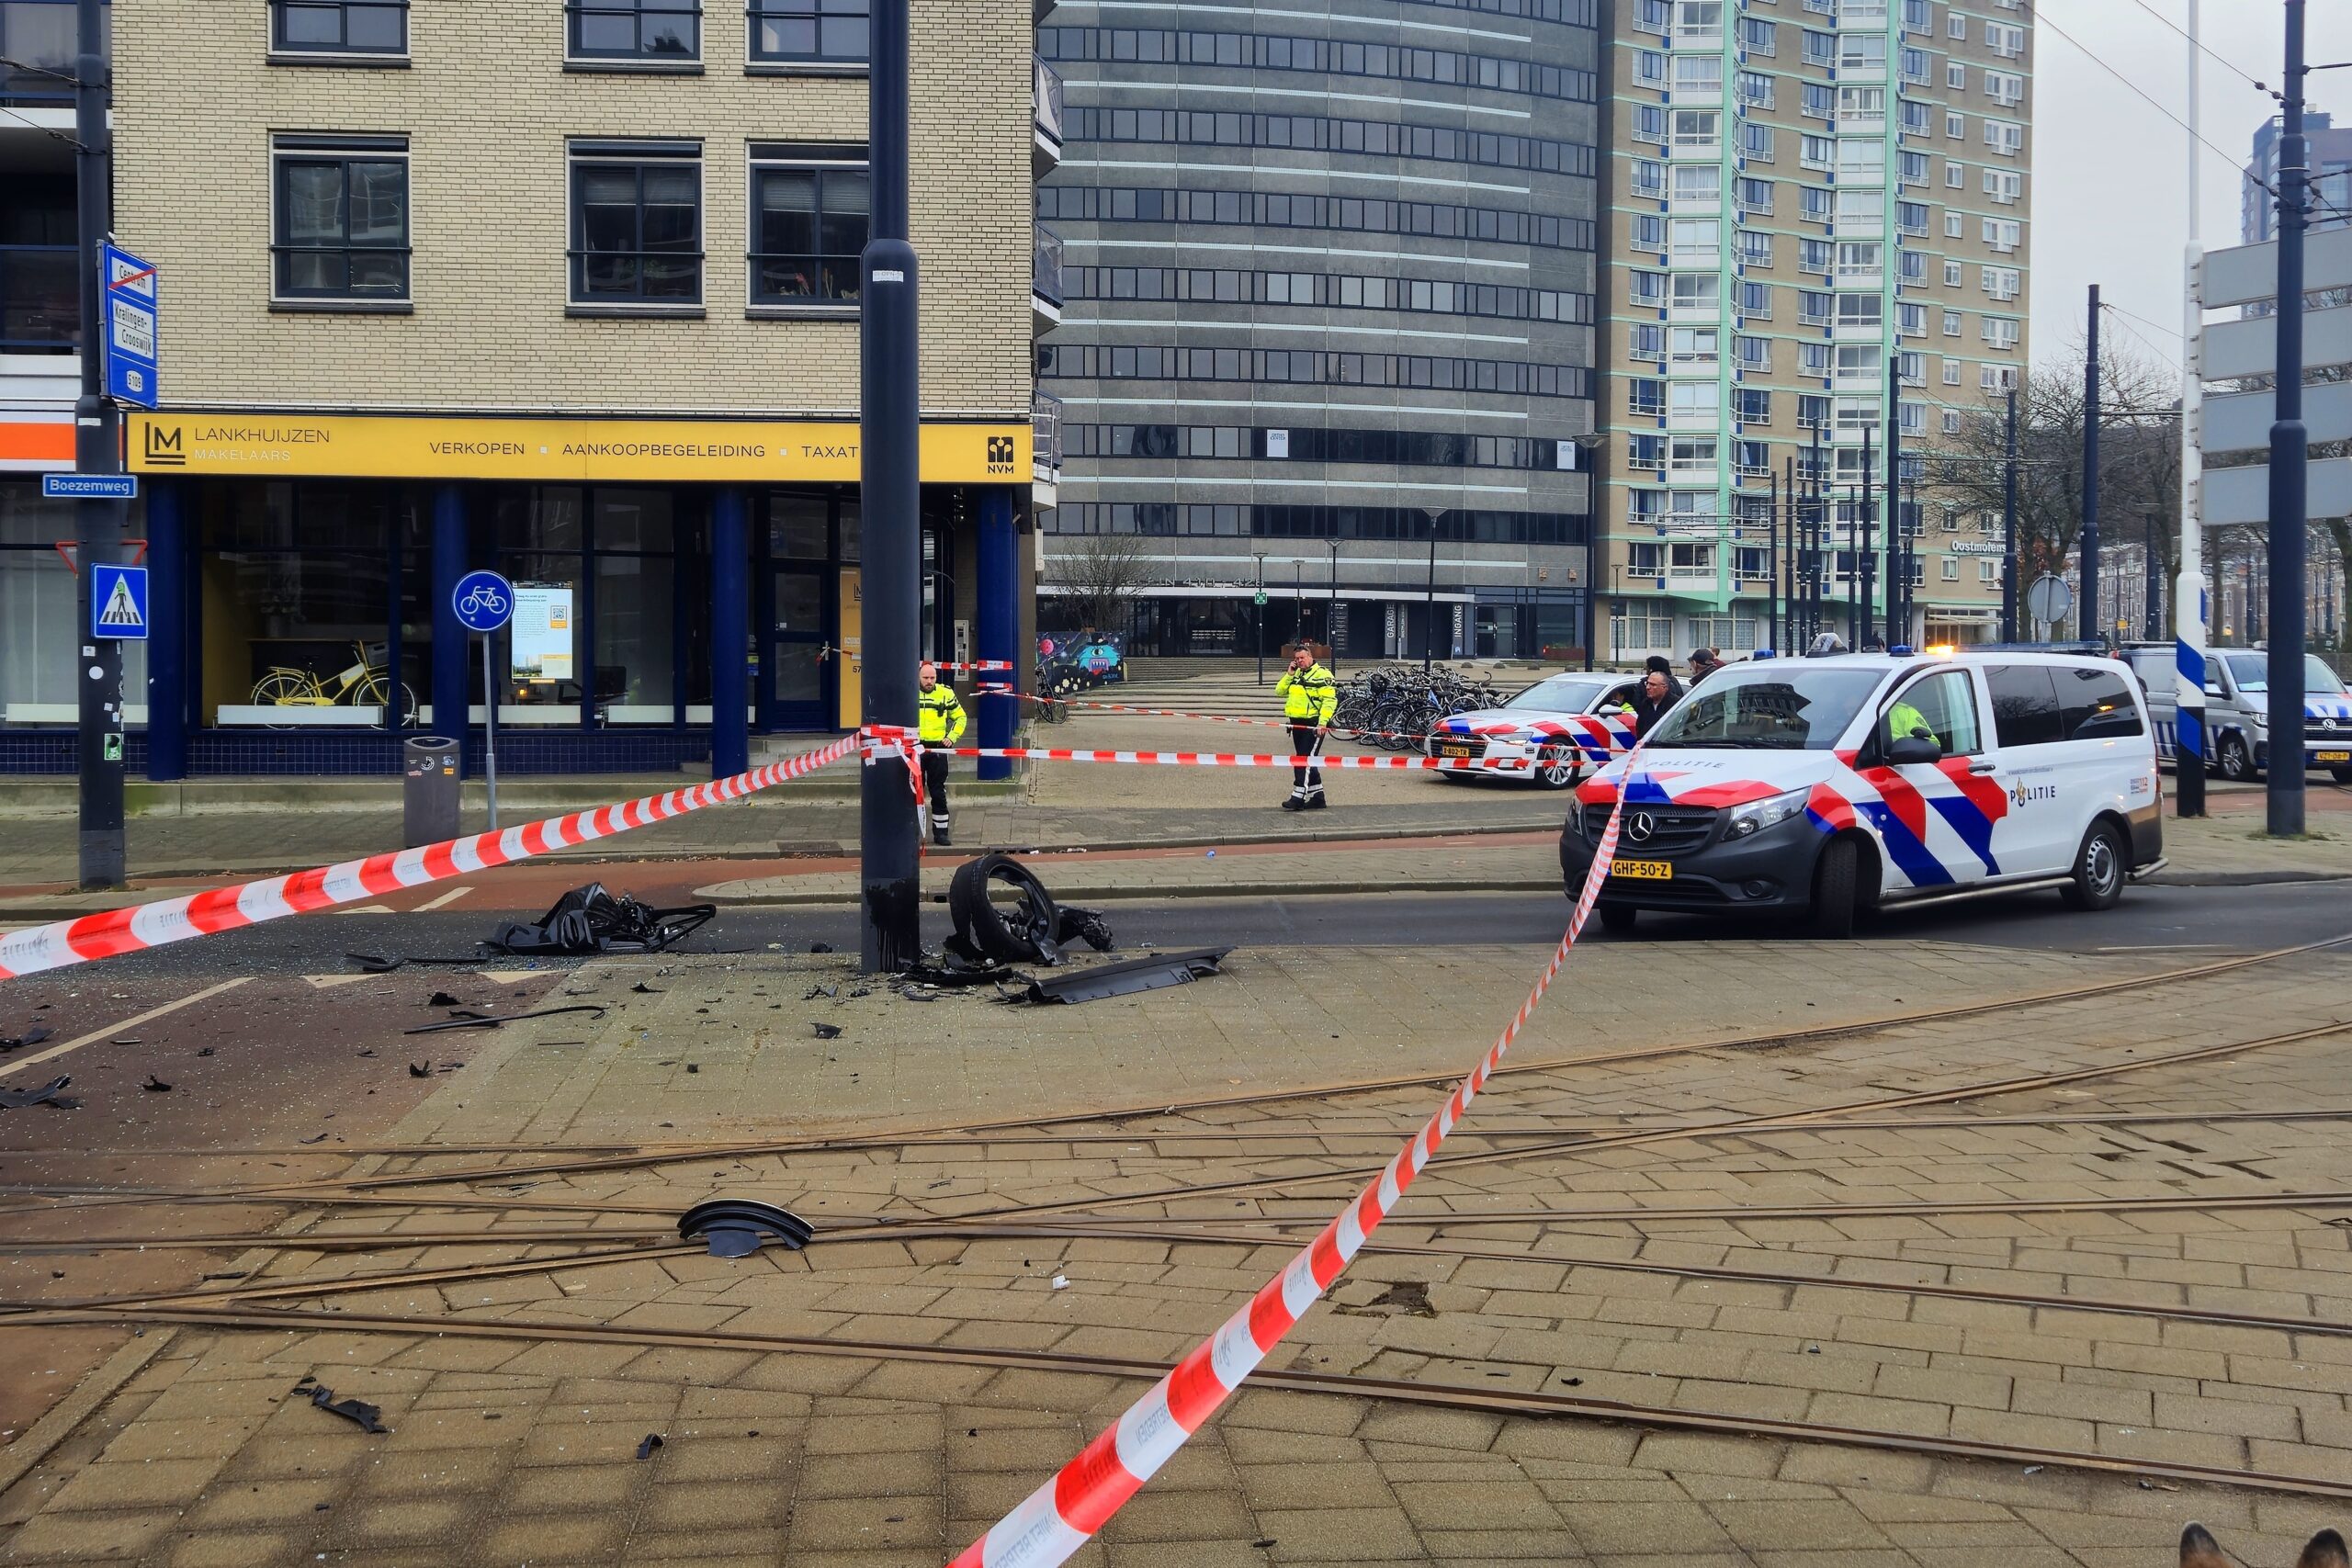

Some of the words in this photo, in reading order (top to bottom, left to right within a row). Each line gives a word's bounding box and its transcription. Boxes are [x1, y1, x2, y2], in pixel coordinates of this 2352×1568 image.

[119, 265, 146, 289] Centrum
[115, 303, 148, 328] Kralingen-
[121, 329, 152, 355] Crooswijk
[195, 427, 330, 443] LANKHUIJZEN
[195, 449, 291, 461] MAKELAARS
[429, 442, 525, 455] VERKOPEN
[562, 444, 765, 457] AANKOOPBEGELEIDING
[988, 465, 1013, 474] NVM
[50, 479, 130, 495] Boezemweg
[1386, 604, 1395, 638] GARAGE
[1454, 604, 1463, 637] INGANG
[1645, 760, 1726, 769] POLITIE
[2010, 784, 2056, 807] POLITIE
[1614, 862, 1668, 877] GHF-50-Z
